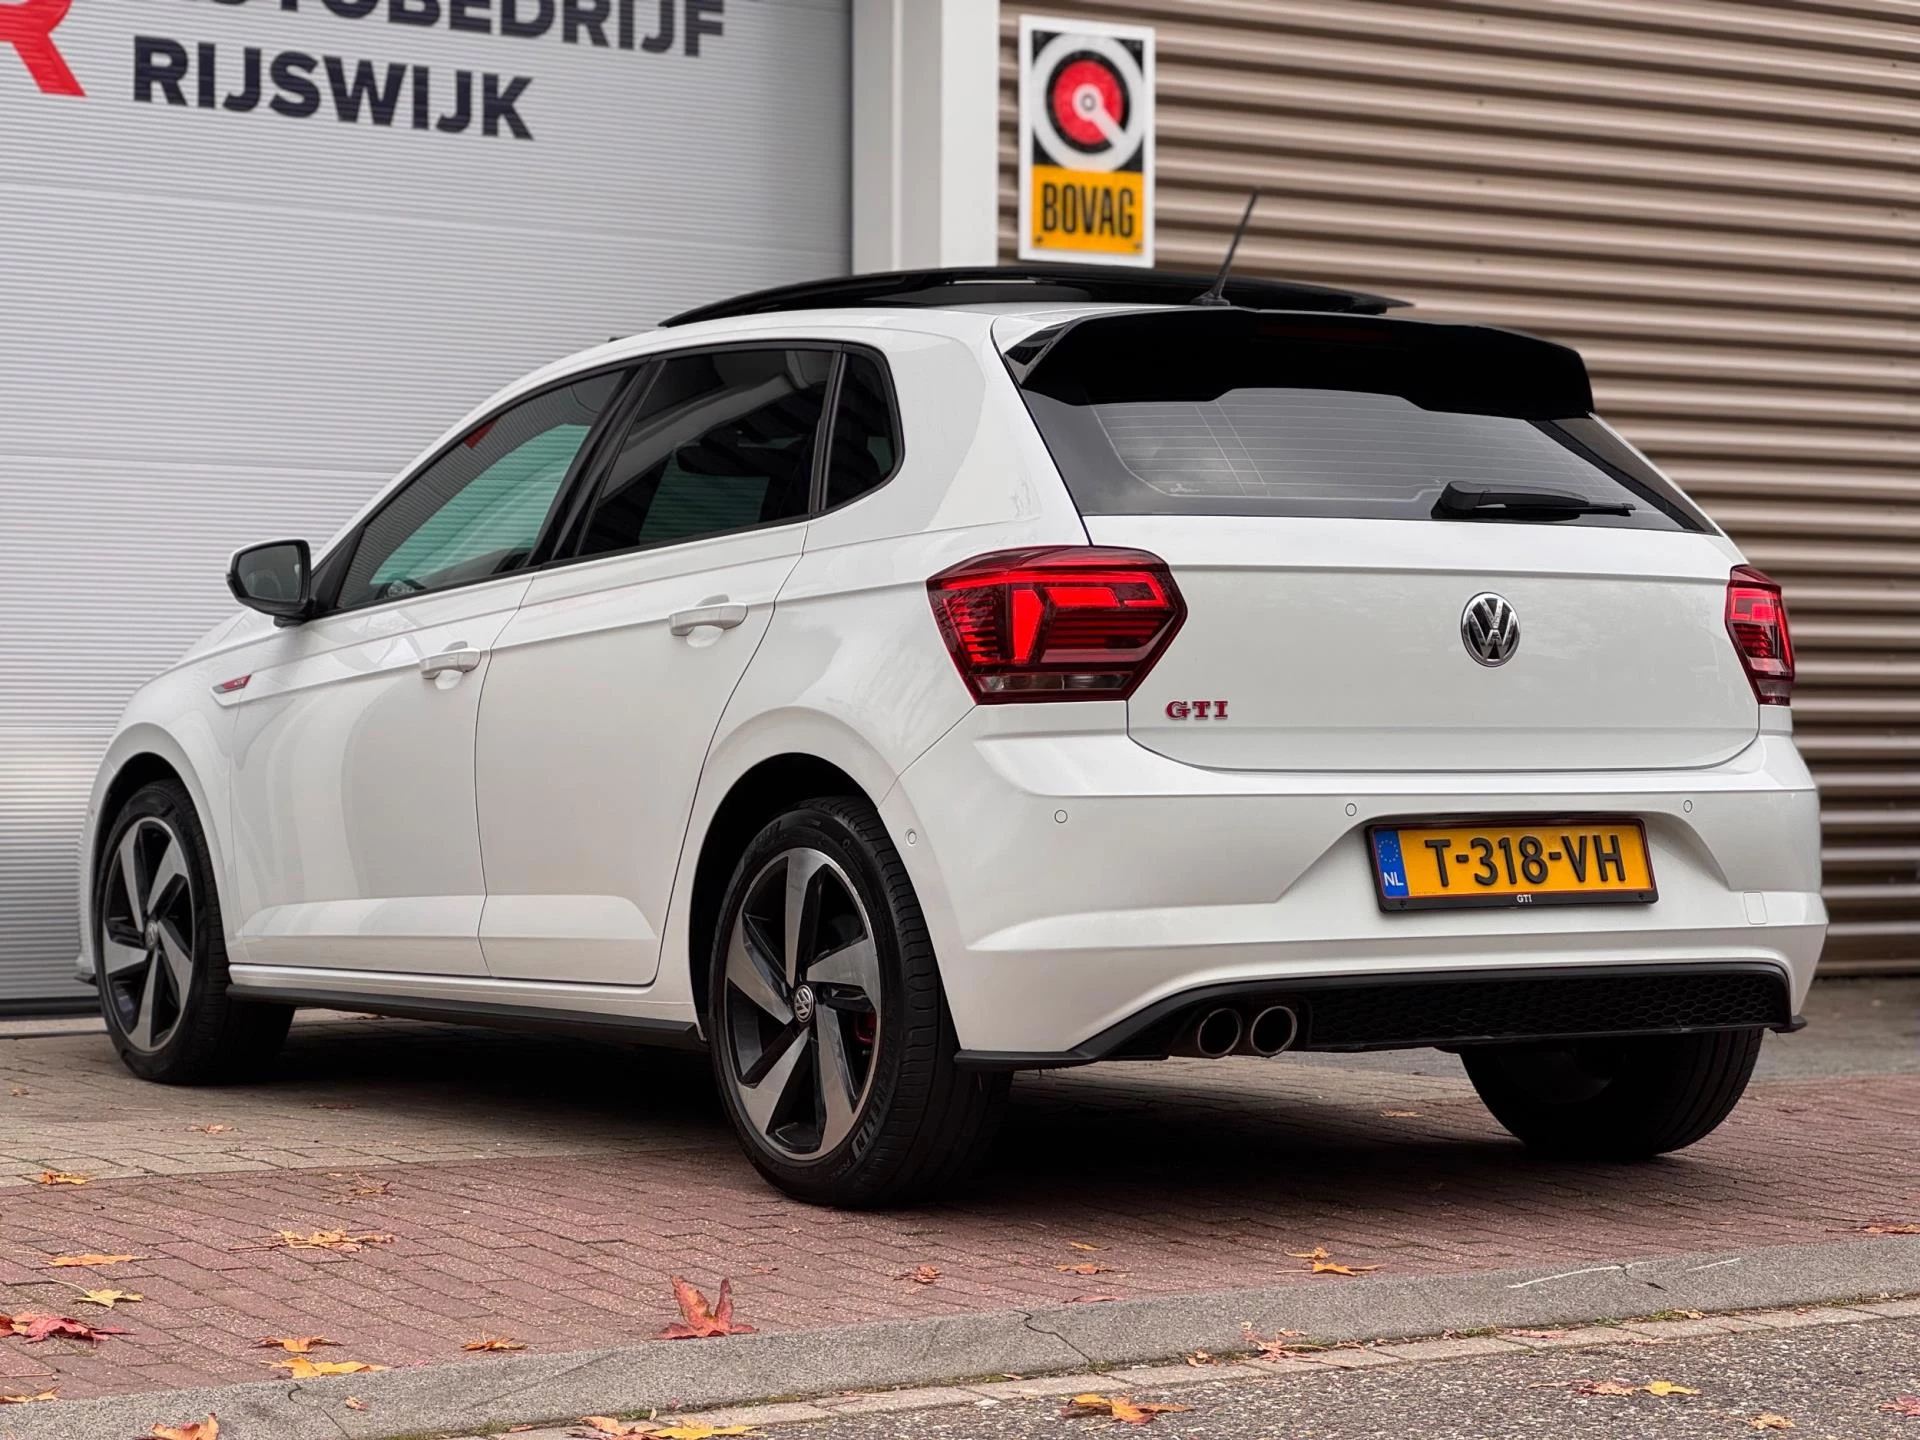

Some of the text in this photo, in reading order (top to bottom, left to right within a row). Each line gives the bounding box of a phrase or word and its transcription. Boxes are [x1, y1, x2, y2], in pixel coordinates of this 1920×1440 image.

[134, 35, 534, 140] RIJSWIJK
[1042, 183, 1134, 238] BOVAG
[1165, 700, 1229, 720] GTI
[1424, 834, 1626, 887] T-318-VH
[1384, 872, 1403, 886] NL
[1516, 894, 1533, 903] GTI
